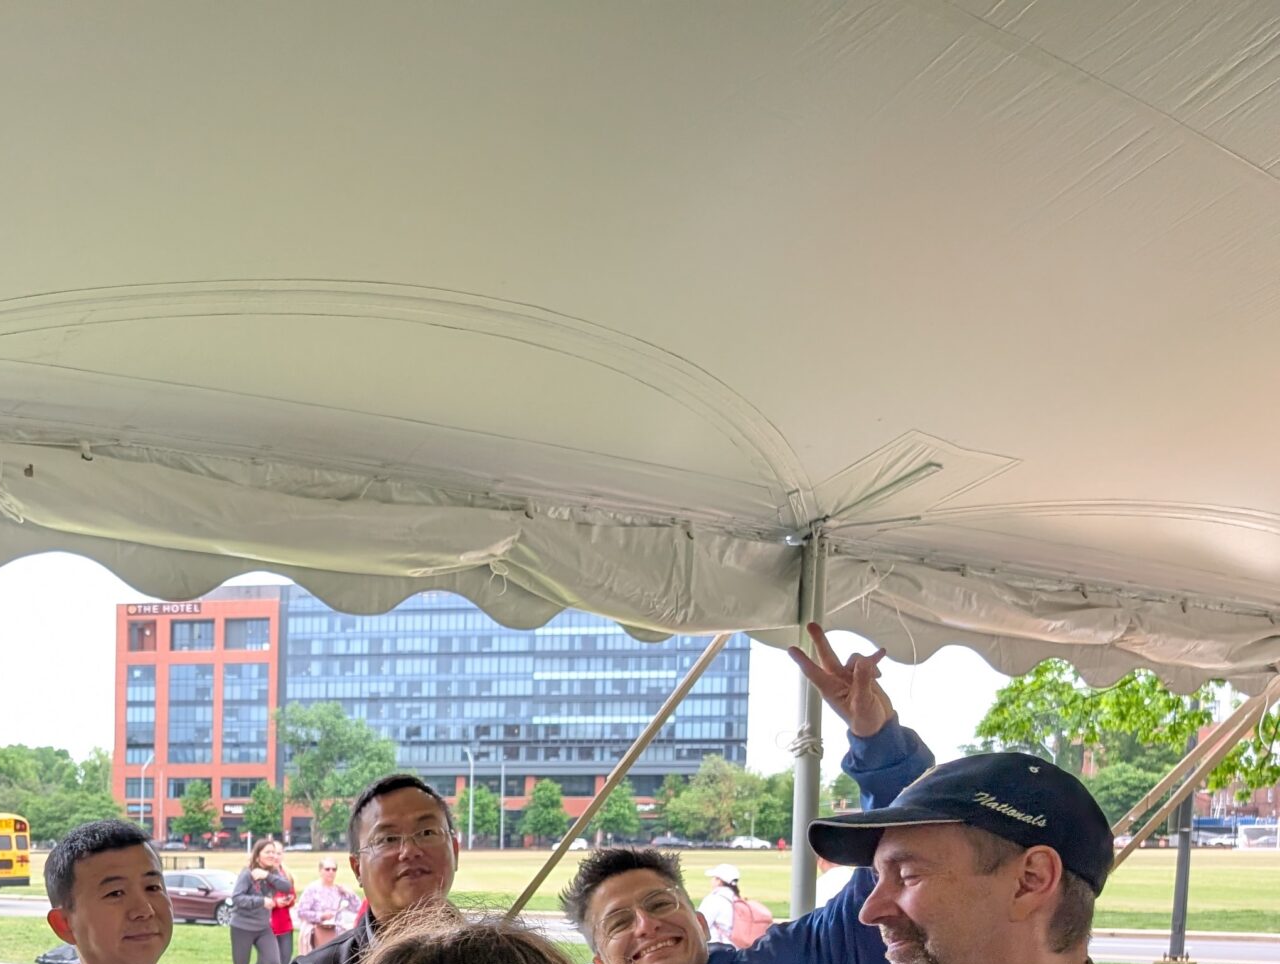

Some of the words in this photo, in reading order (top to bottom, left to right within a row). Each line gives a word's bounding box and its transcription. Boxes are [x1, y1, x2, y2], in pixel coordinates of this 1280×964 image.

[137, 604, 159, 614] THE
[162, 603, 200, 613] HOTEL
[974, 791, 1048, 829] Nationals
